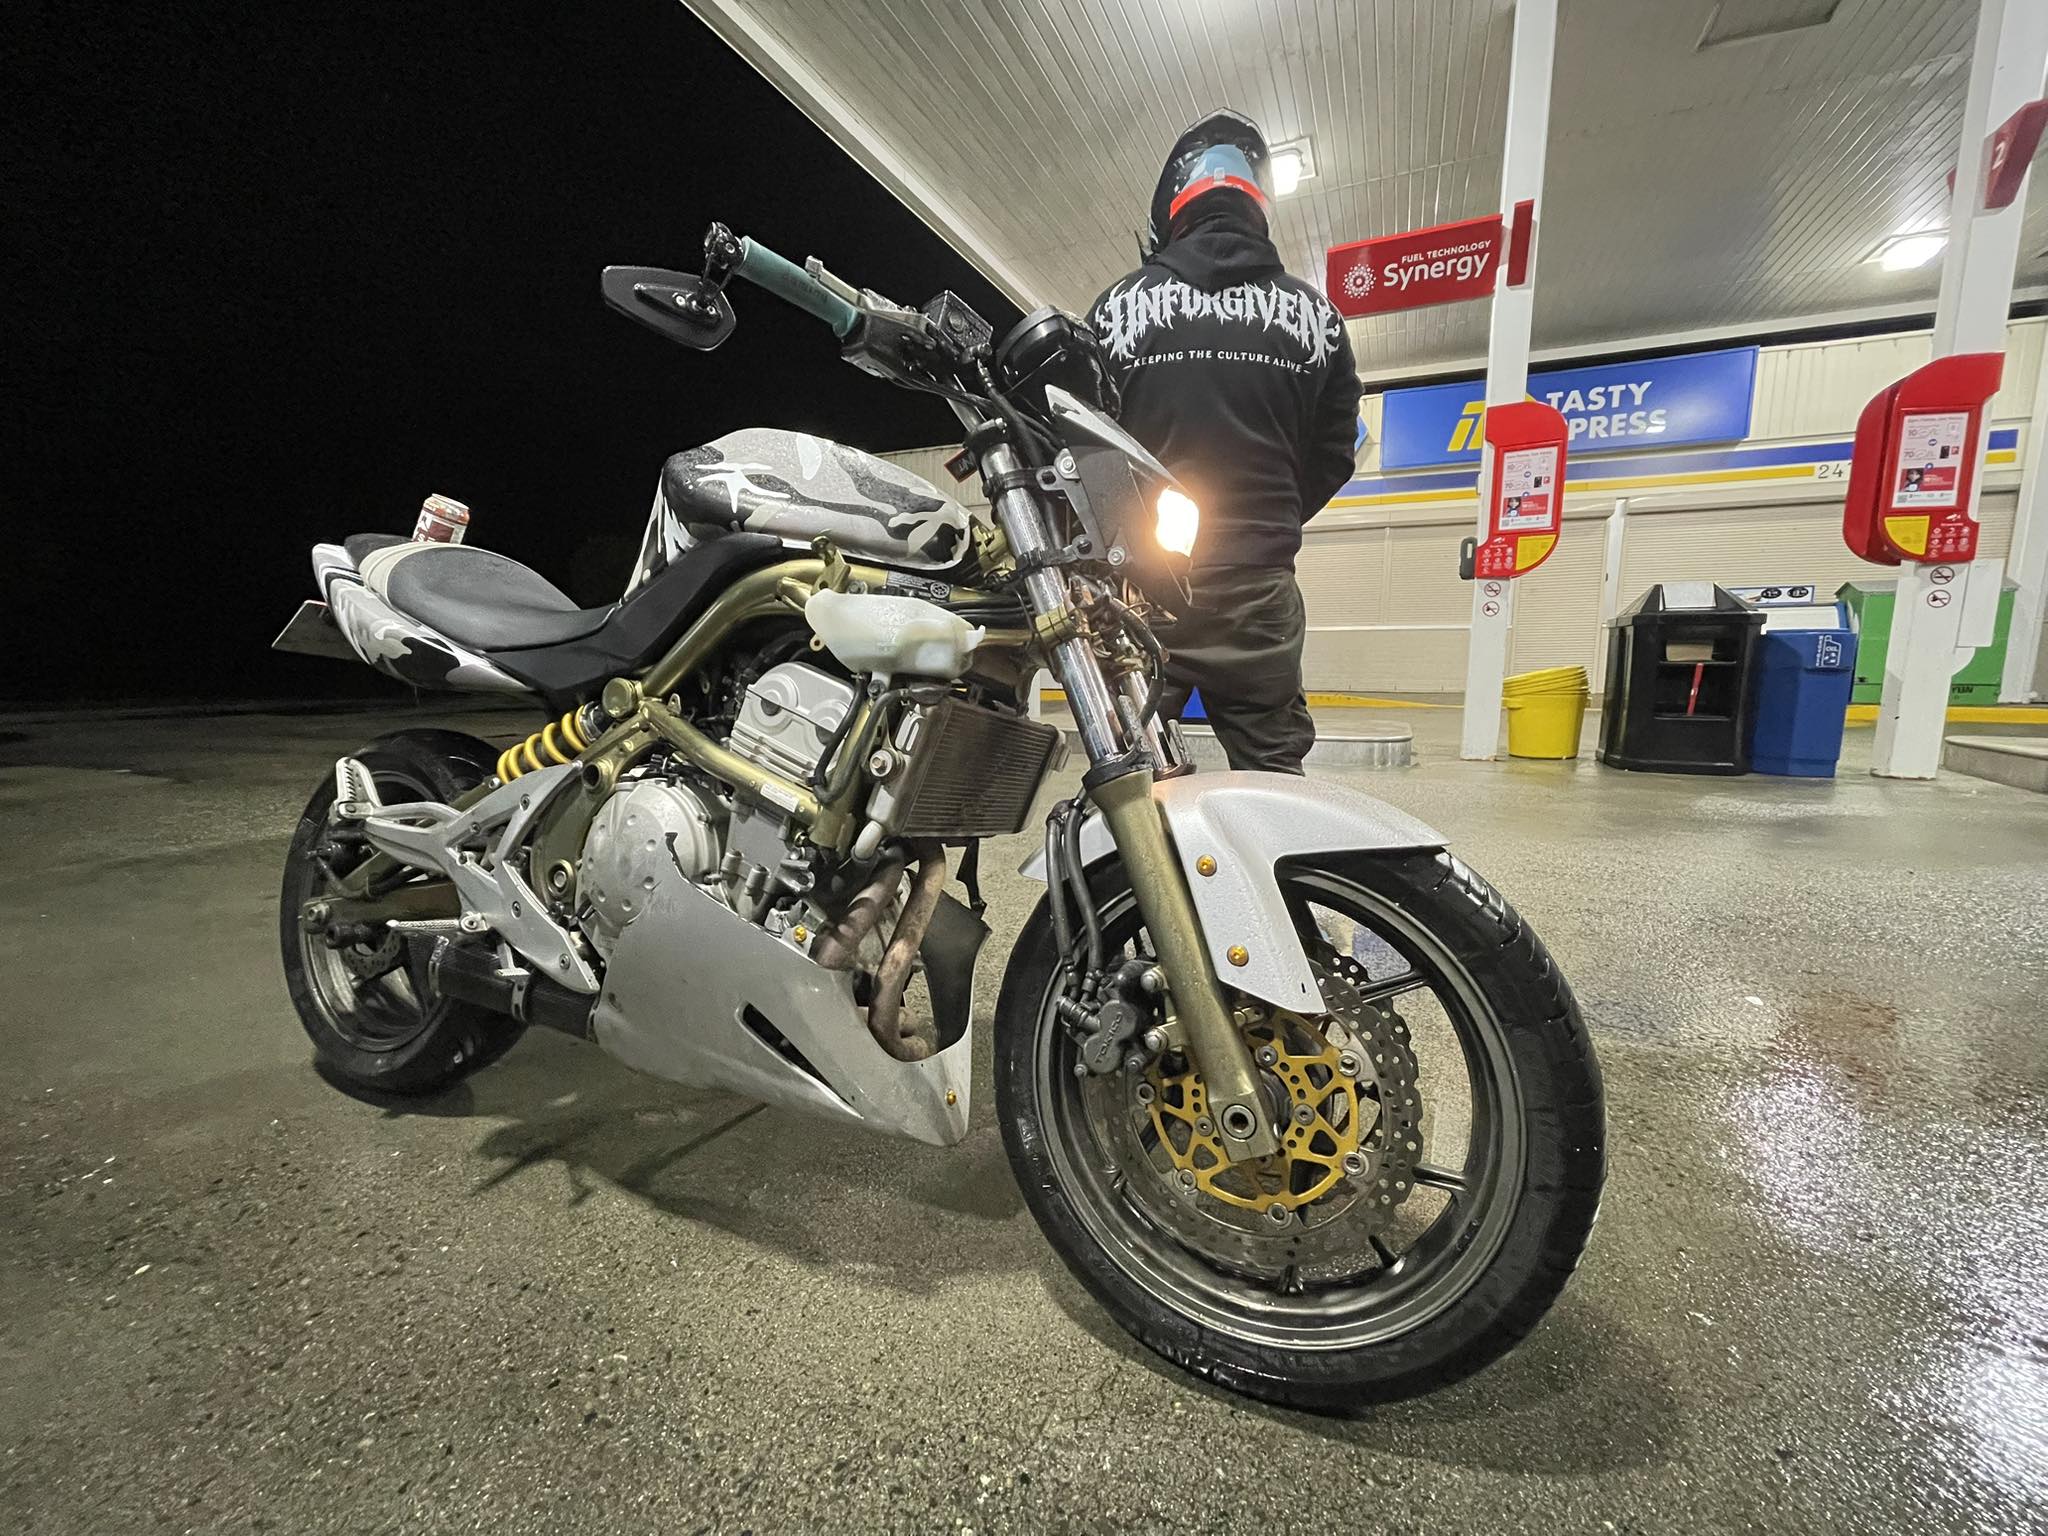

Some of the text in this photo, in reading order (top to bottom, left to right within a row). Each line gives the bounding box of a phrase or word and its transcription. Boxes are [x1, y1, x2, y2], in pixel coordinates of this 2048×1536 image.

[1401, 239, 1492, 264] FUEL TECHNOLOGY
[1383, 252, 1490, 291] Synergy
[1132, 350, 1302, 373] KEEPING THE CULTURE ALIVE
[1545, 381, 1652, 414] TASTY
[1567, 409, 1667, 441] PRESS
